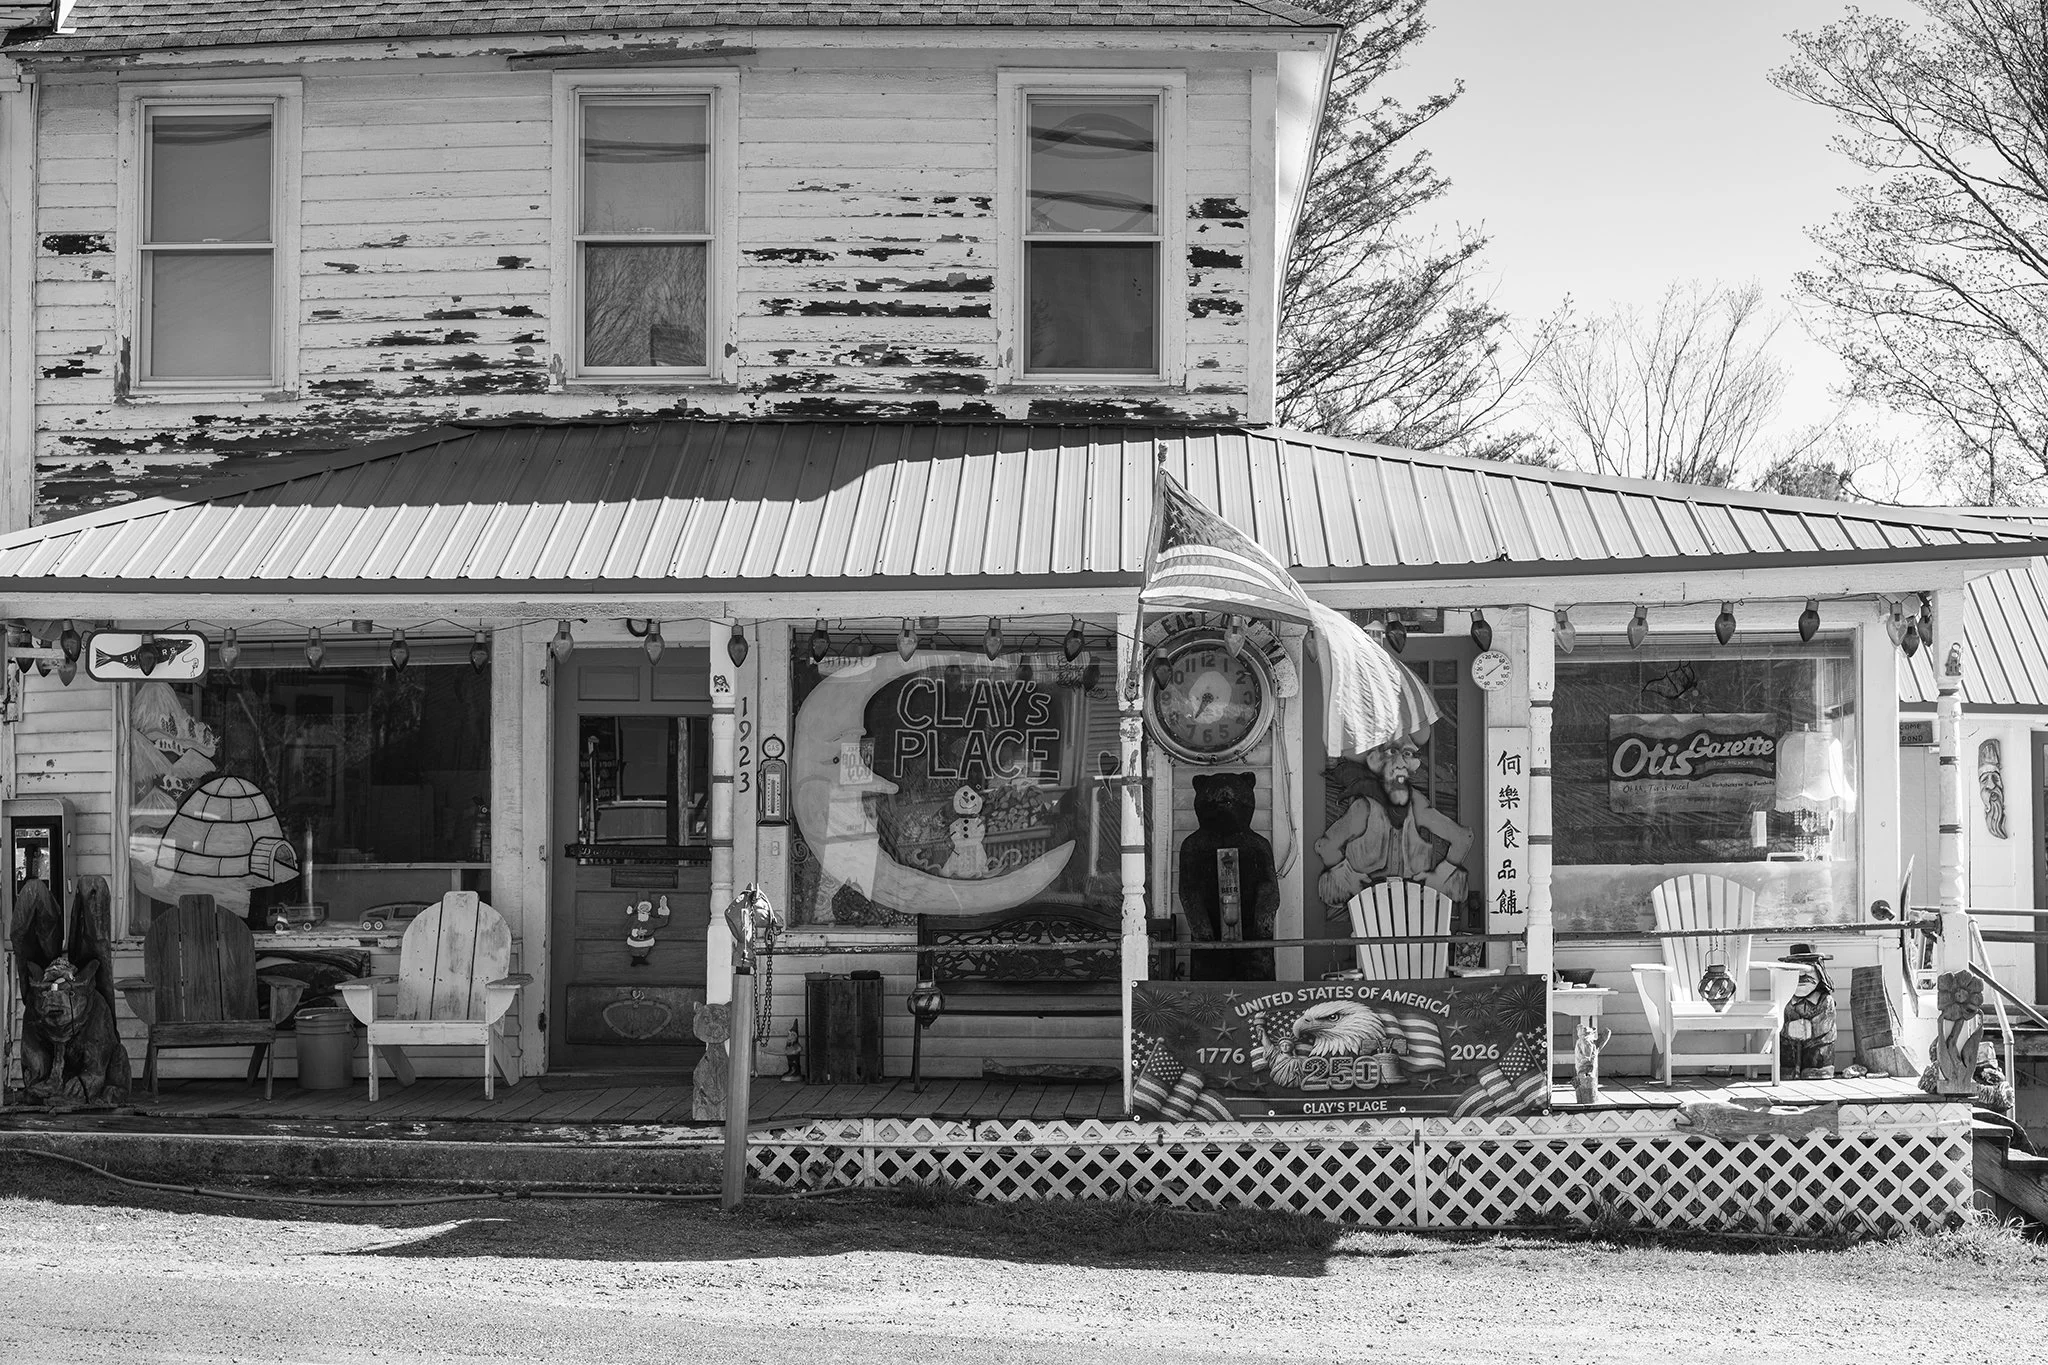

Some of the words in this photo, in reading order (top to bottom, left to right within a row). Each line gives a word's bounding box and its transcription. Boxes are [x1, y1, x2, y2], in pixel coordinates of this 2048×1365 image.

[1161, 611, 1207, 634] EAST
[122, 647, 176, 663] SHRS
[1201, 654, 1216, 667] 12
[1186, 658, 1196, 672] 11
[1223, 658, 1228, 672] 1
[1236, 671, 1247, 685] 2
[1186, 724, 1197, 739] 7
[1203, 729, 1213, 744] 6
[1219, 724, 1229, 739] 5
[739, 696, 752, 793] 1923
[767, 744, 779, 752] GAS
[894, 729, 1060, 780] PLACE
[1612, 738, 1695, 777] Otis
[1689, 733, 1774, 758] Gazette
[1234, 991, 1294, 1017] UNITED
[1297, 986, 1354, 1002] STATES
[1357, 986, 1380, 1001] OF
[1381, 989, 1451, 1018] AMERICA
[1195, 1047, 1245, 1064] 1776
[1450, 1044, 1500, 1061] 2026
[1300, 1055, 1381, 1090] 250
[1303, 1101, 1345, 1114] CLAY'S
[1347, 1100, 1388, 1112] PLACE
